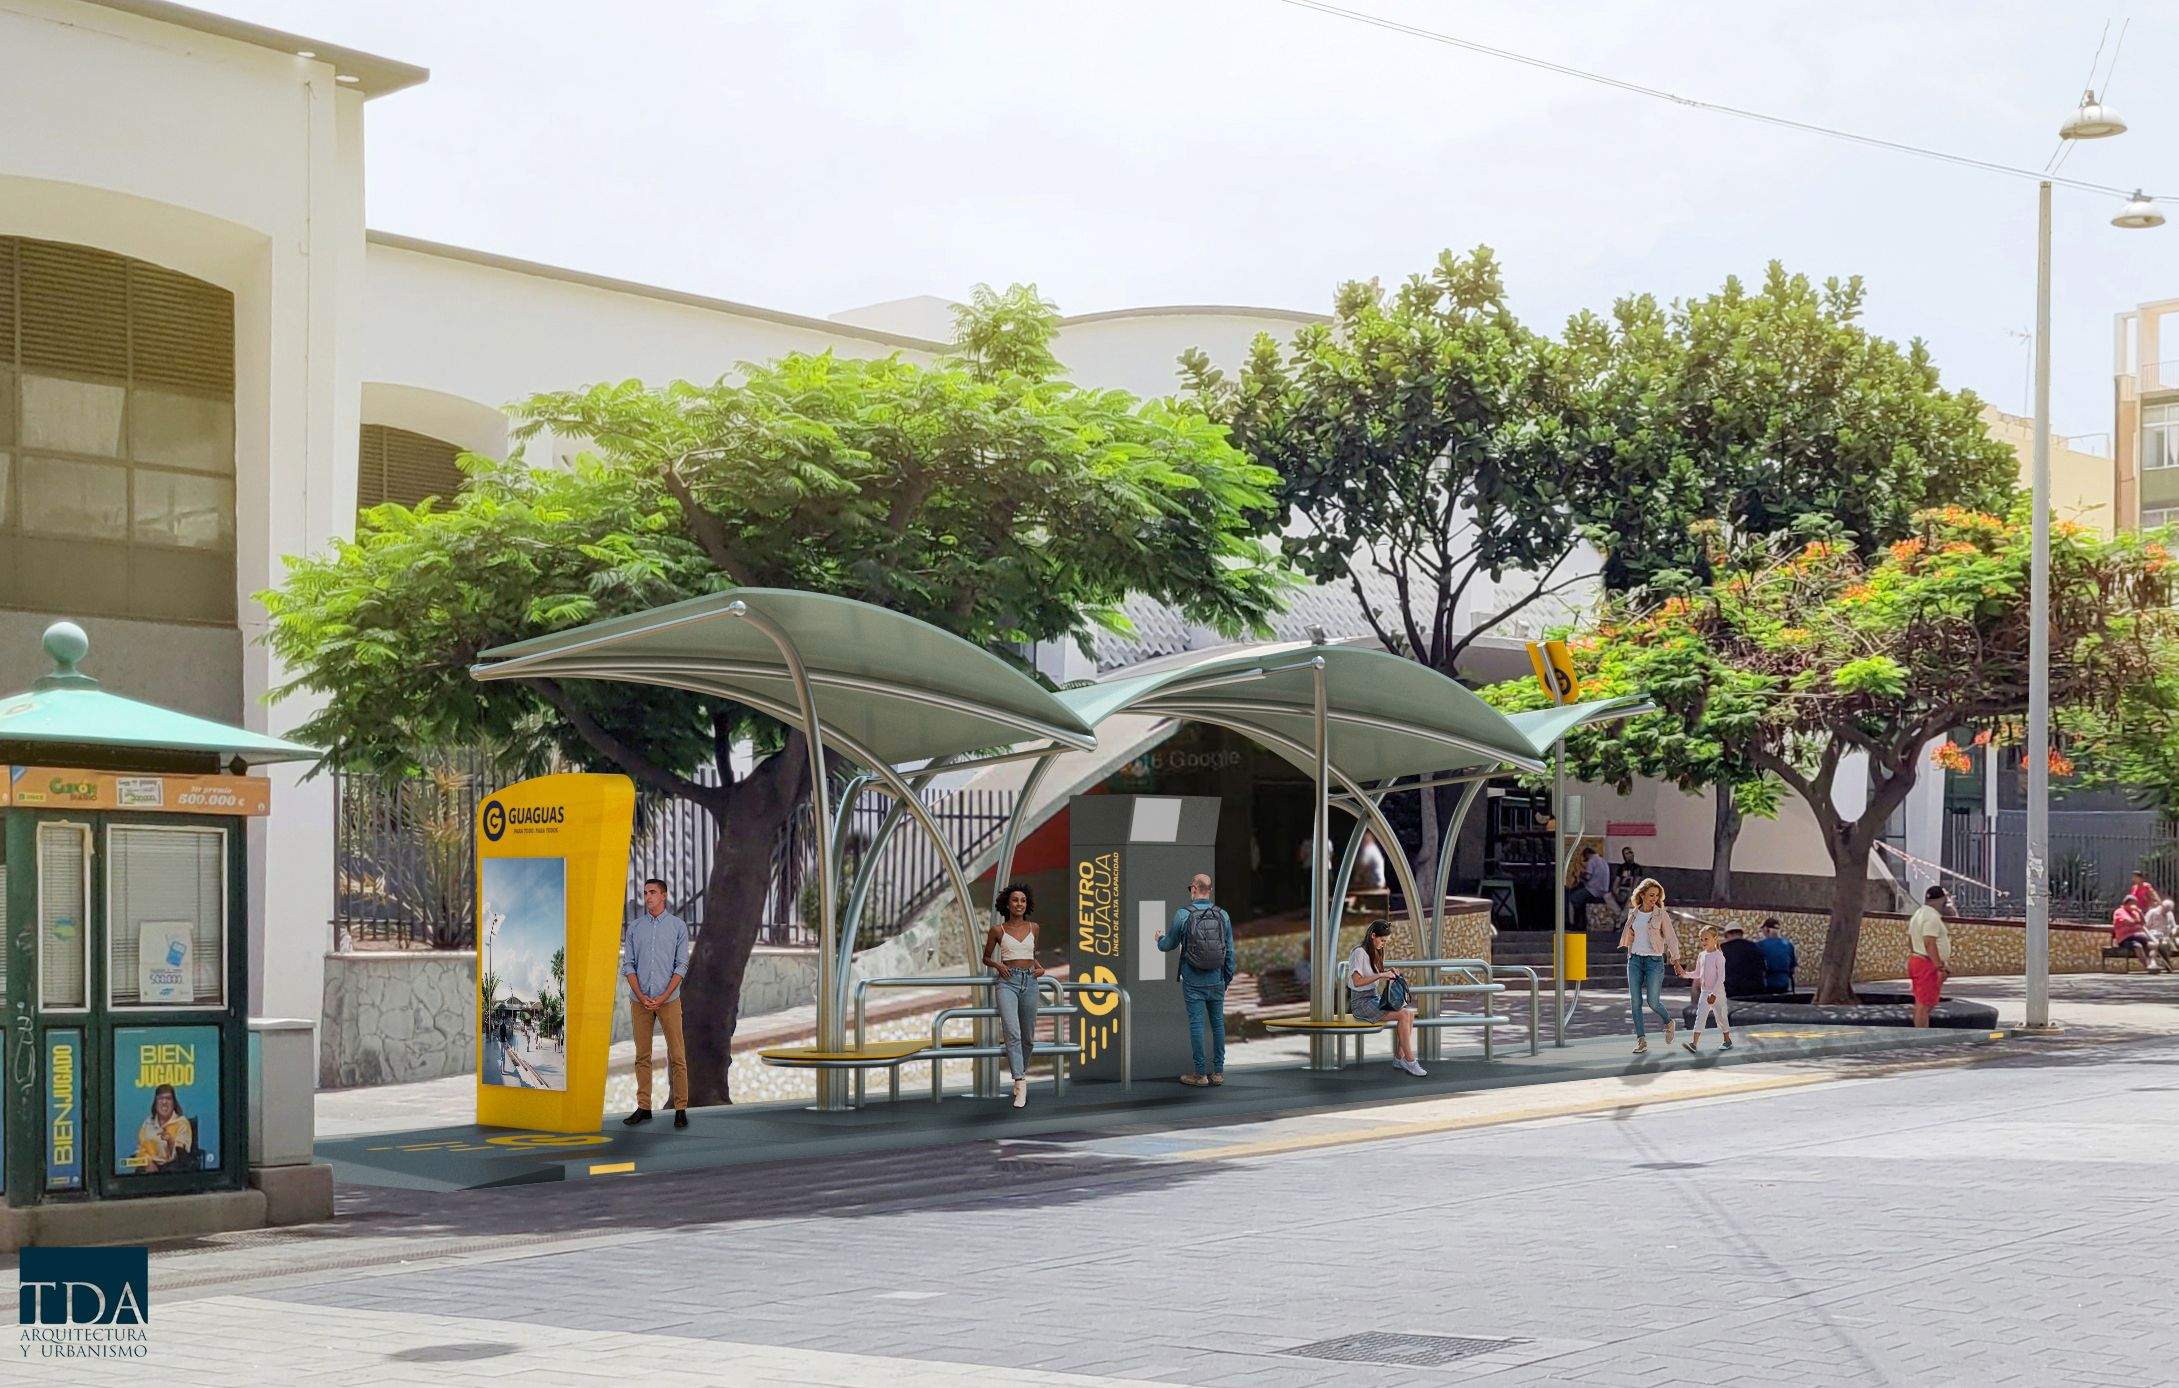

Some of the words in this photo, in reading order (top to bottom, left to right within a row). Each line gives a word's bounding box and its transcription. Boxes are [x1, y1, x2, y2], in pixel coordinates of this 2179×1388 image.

[508, 806, 564, 825] GUAGUAS
[1079, 861, 1094, 953] METRO
[1095, 854, 1111, 956] GUAGUA
[1113, 921, 1119, 931] DE
[52, 1044, 73, 1103] JUGADO
[140, 1044, 194, 1064] BIEN
[135, 1064, 194, 1088] JUGADO
[53, 1104, 73, 1165] BIEN
